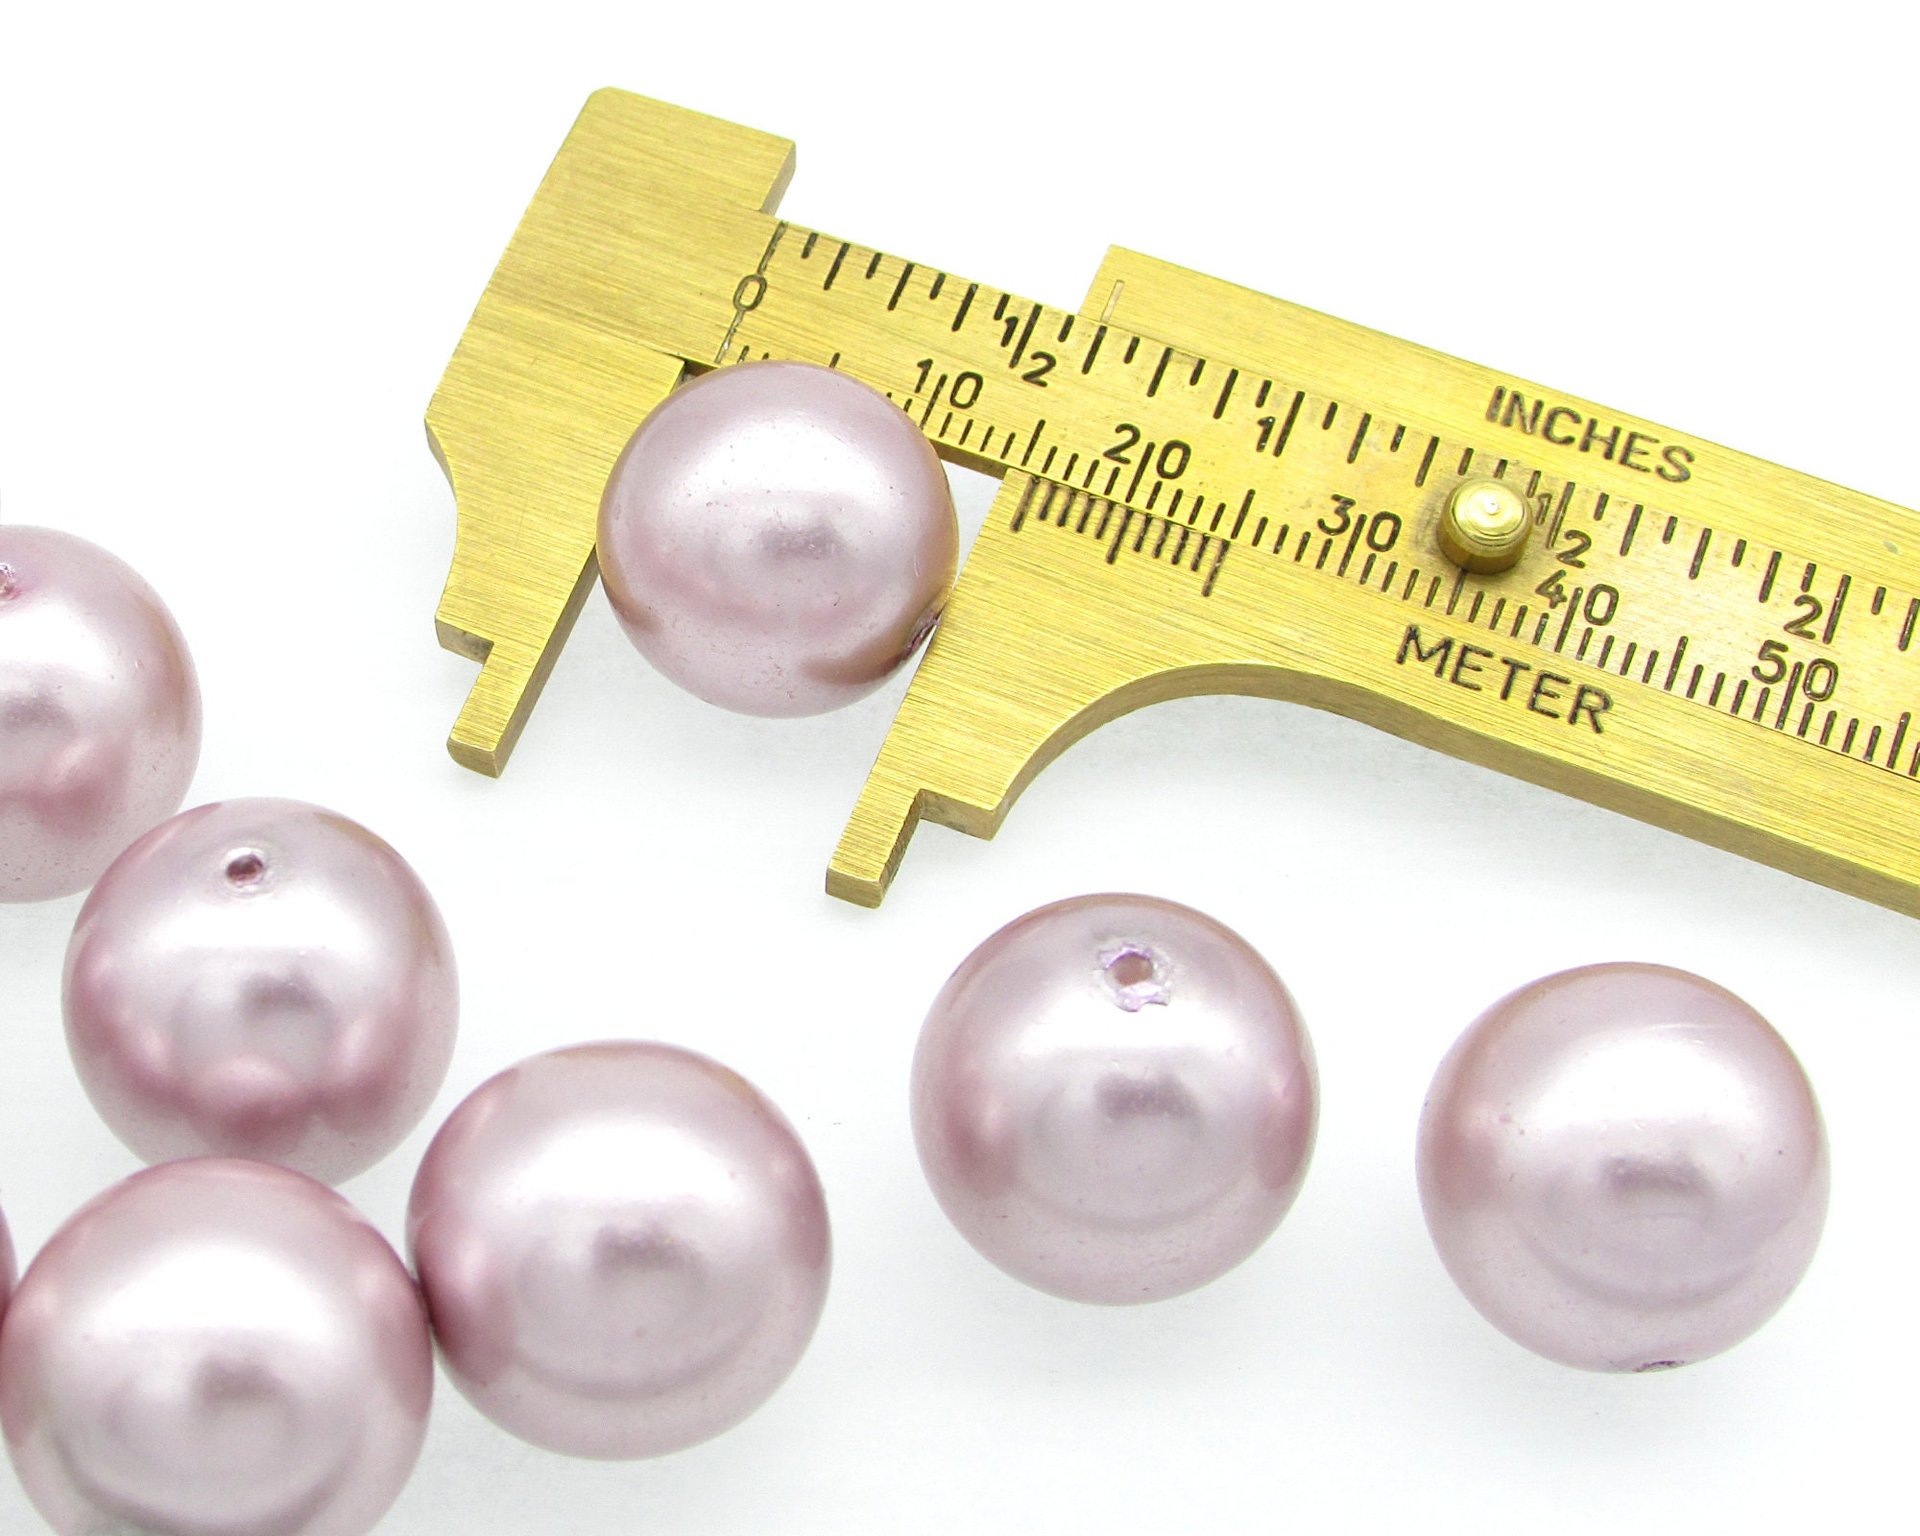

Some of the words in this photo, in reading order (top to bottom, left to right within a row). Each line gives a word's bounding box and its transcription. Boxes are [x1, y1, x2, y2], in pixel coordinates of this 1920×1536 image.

[733, 274, 767, 311] 0
[917, 358, 984, 409] 10
[1103, 423, 1192, 480] 20
[1485, 385, 1696, 483] INCHES
[1317, 494, 1402, 553] 30
[1535, 569, 1620, 626] 40
[1783, 595, 1823, 640] 2
[1396, 625, 1614, 734] METER
[1752, 639, 1840, 702] 50
